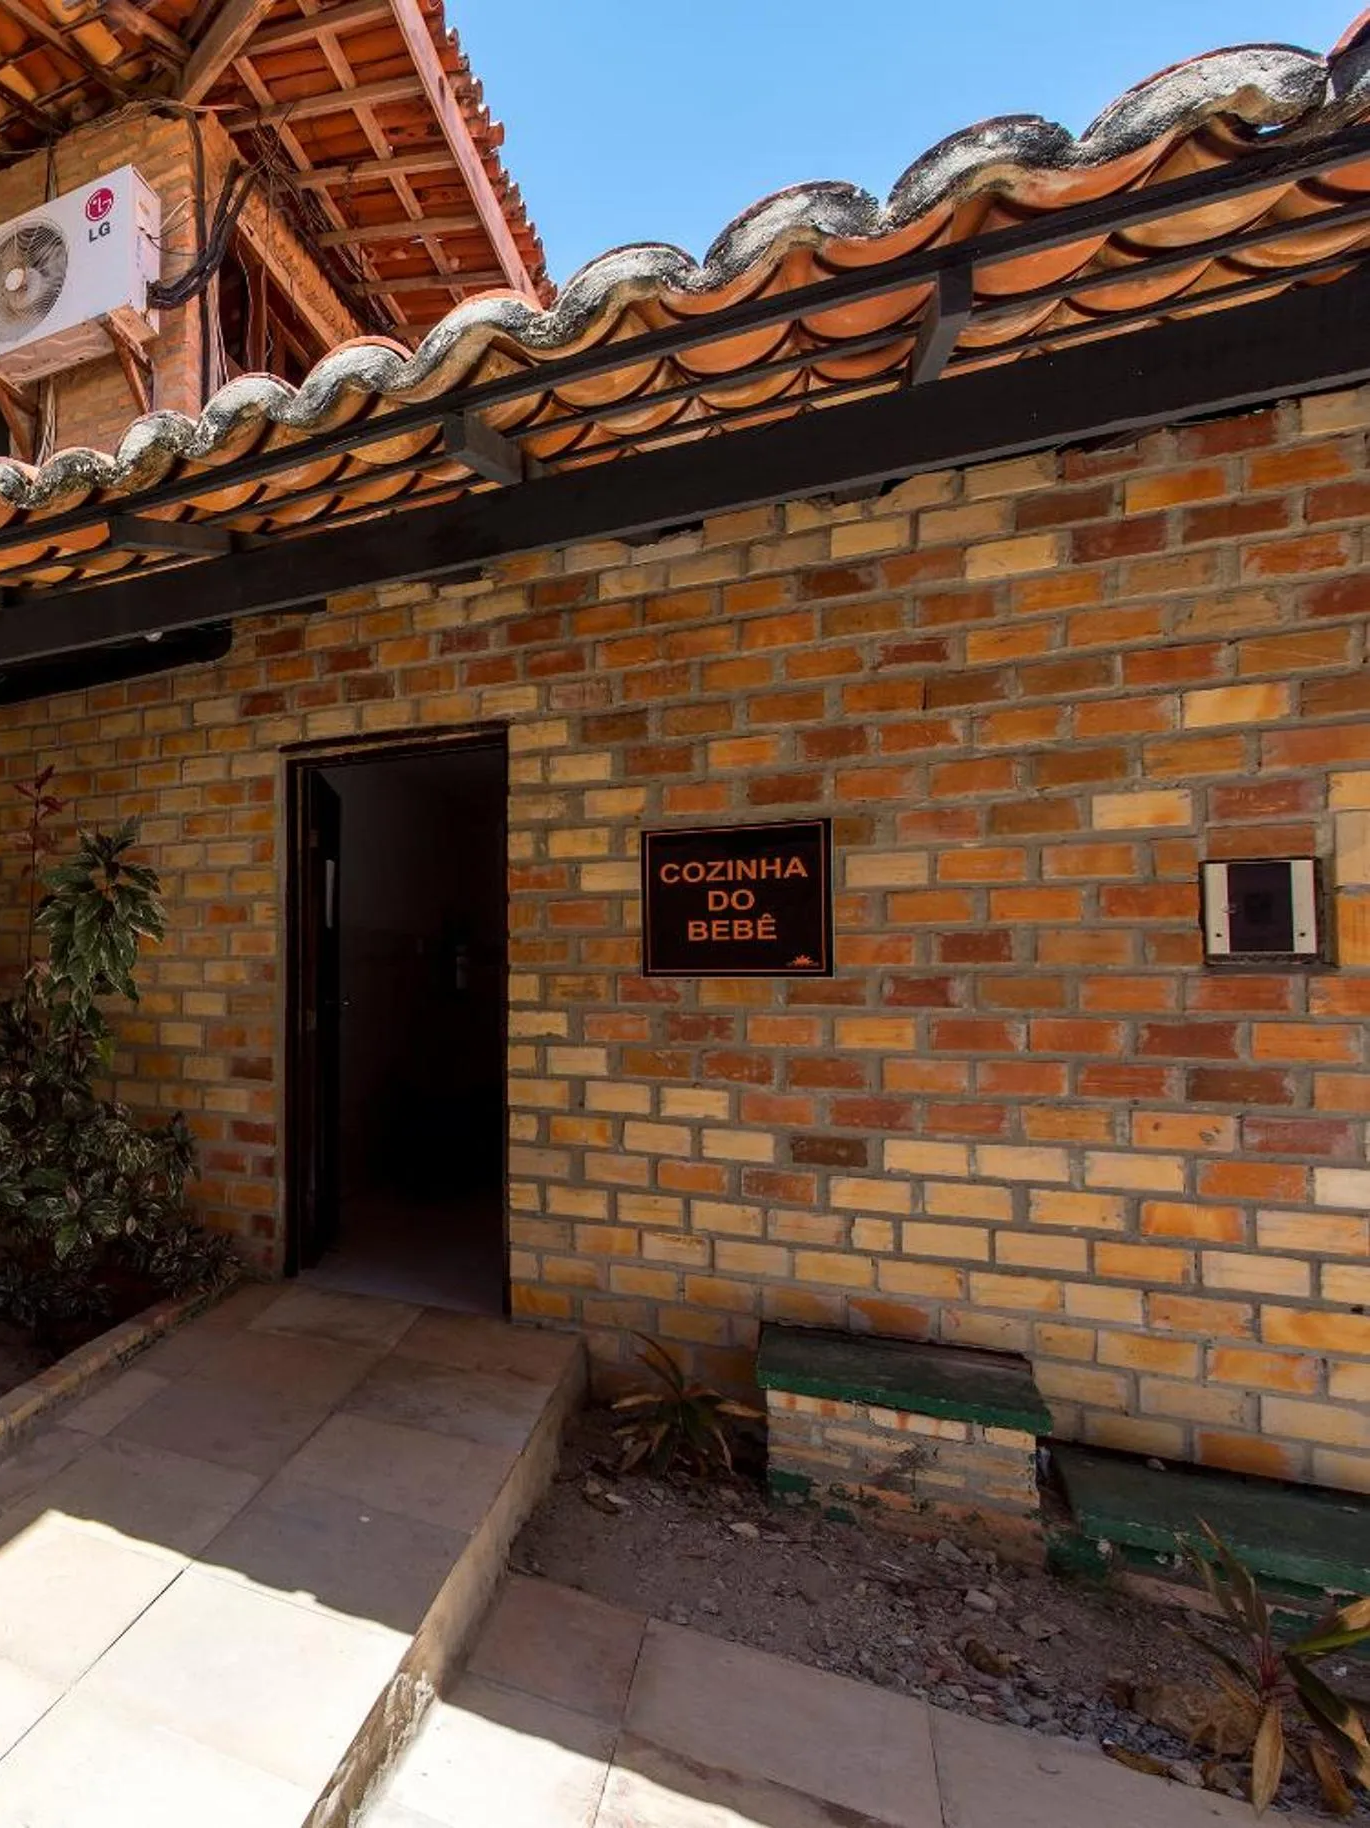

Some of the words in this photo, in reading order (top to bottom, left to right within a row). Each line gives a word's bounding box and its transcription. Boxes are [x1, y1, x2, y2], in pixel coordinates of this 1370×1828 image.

[89, 221, 110, 243] LG
[660, 856, 808, 884] COZINHA
[708, 889, 755, 911] DO
[688, 913, 777, 941] BEBÊ
